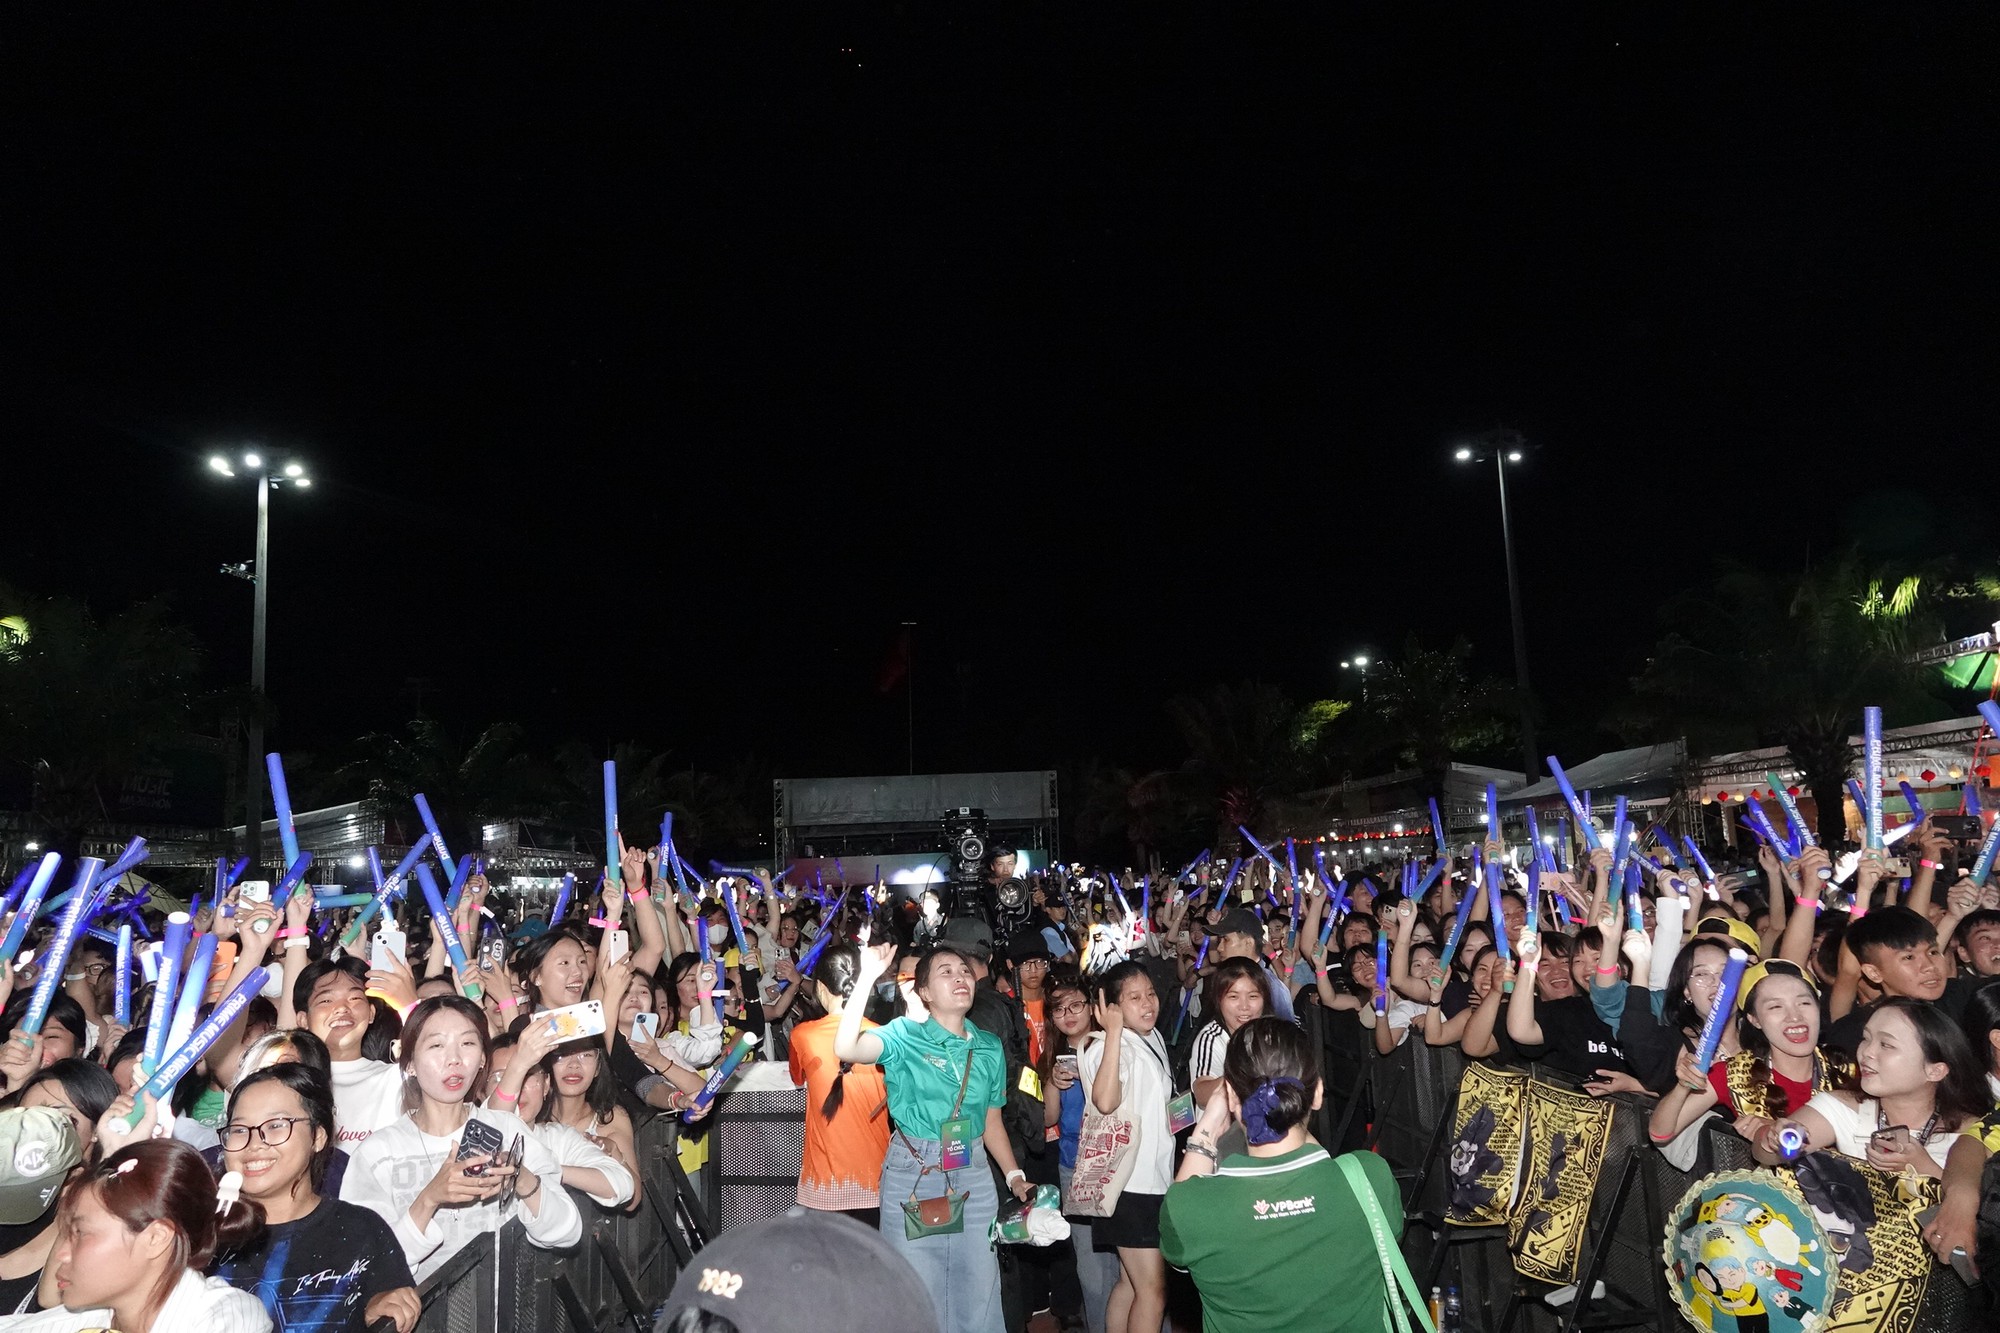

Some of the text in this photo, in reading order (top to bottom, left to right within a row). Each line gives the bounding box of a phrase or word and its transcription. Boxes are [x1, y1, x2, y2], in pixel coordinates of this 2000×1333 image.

[1873, 738, 1882, 773] PRIME
[429, 830, 450, 861] prime+
[1979, 829, 1998, 856] MUSIC
[1969, 853, 1987, 878] NIGHT
[375, 871, 403, 904] prime+
[431, 909, 459, 948] prime+
[27, 894, 84, 1020] PRIME MUSIC NIGHT
[142, 955, 174, 1060] PRIME MUSIC NIGHT
[1701, 1006, 1718, 1037] MUSIC
[152, 990, 248, 1091] PRIME MUSIC NIGHT
[1270, 1196, 1313, 1213] VPBank
[1893, 1246, 1924, 1264] KNOW
